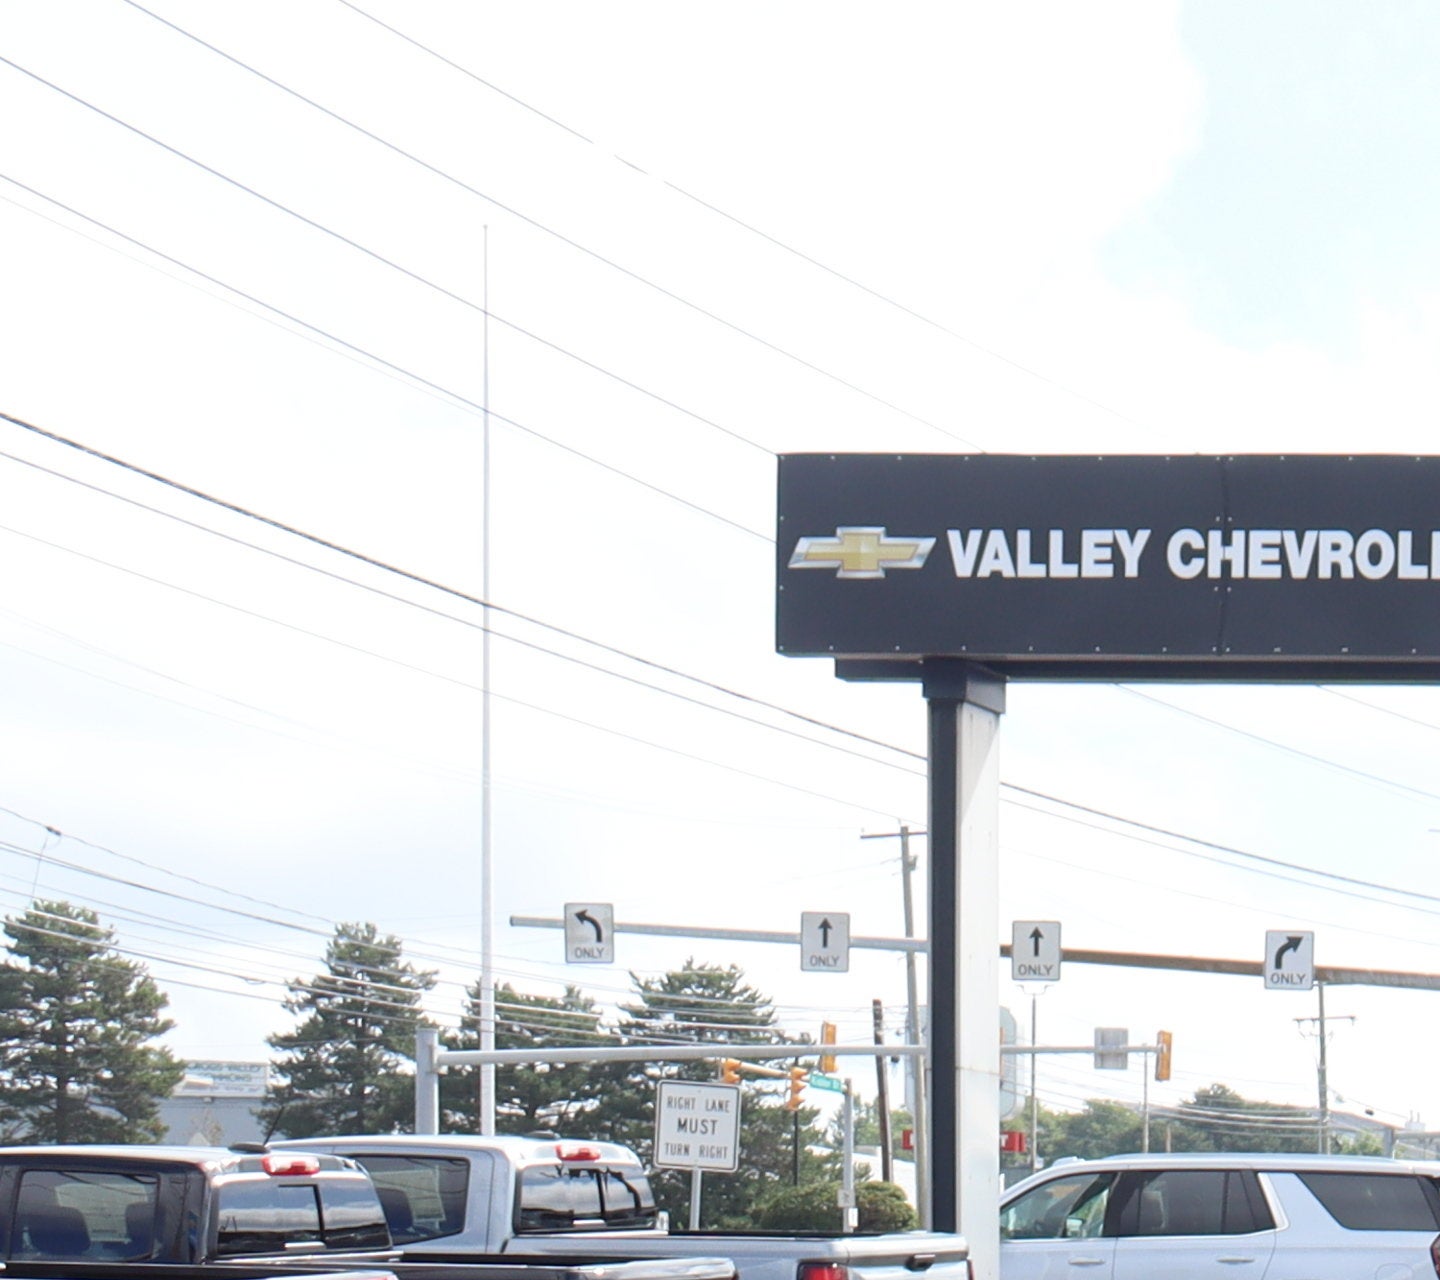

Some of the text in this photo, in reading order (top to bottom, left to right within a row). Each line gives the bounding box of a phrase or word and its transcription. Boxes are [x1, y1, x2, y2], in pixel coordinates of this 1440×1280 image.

[946, 529, 1151, 579] VALLEY
[573, 944, 605, 961] ONLY
[809, 954, 840, 970] ONLY
[1017, 963, 1054, 977] ONLY
[1269, 972, 1308, 987] ONLY
[666, 1095, 731, 1113] RIGHT LANE
[677, 1117, 718, 1136] MUST
[664, 1142, 729, 1160] TURN RIGHT
